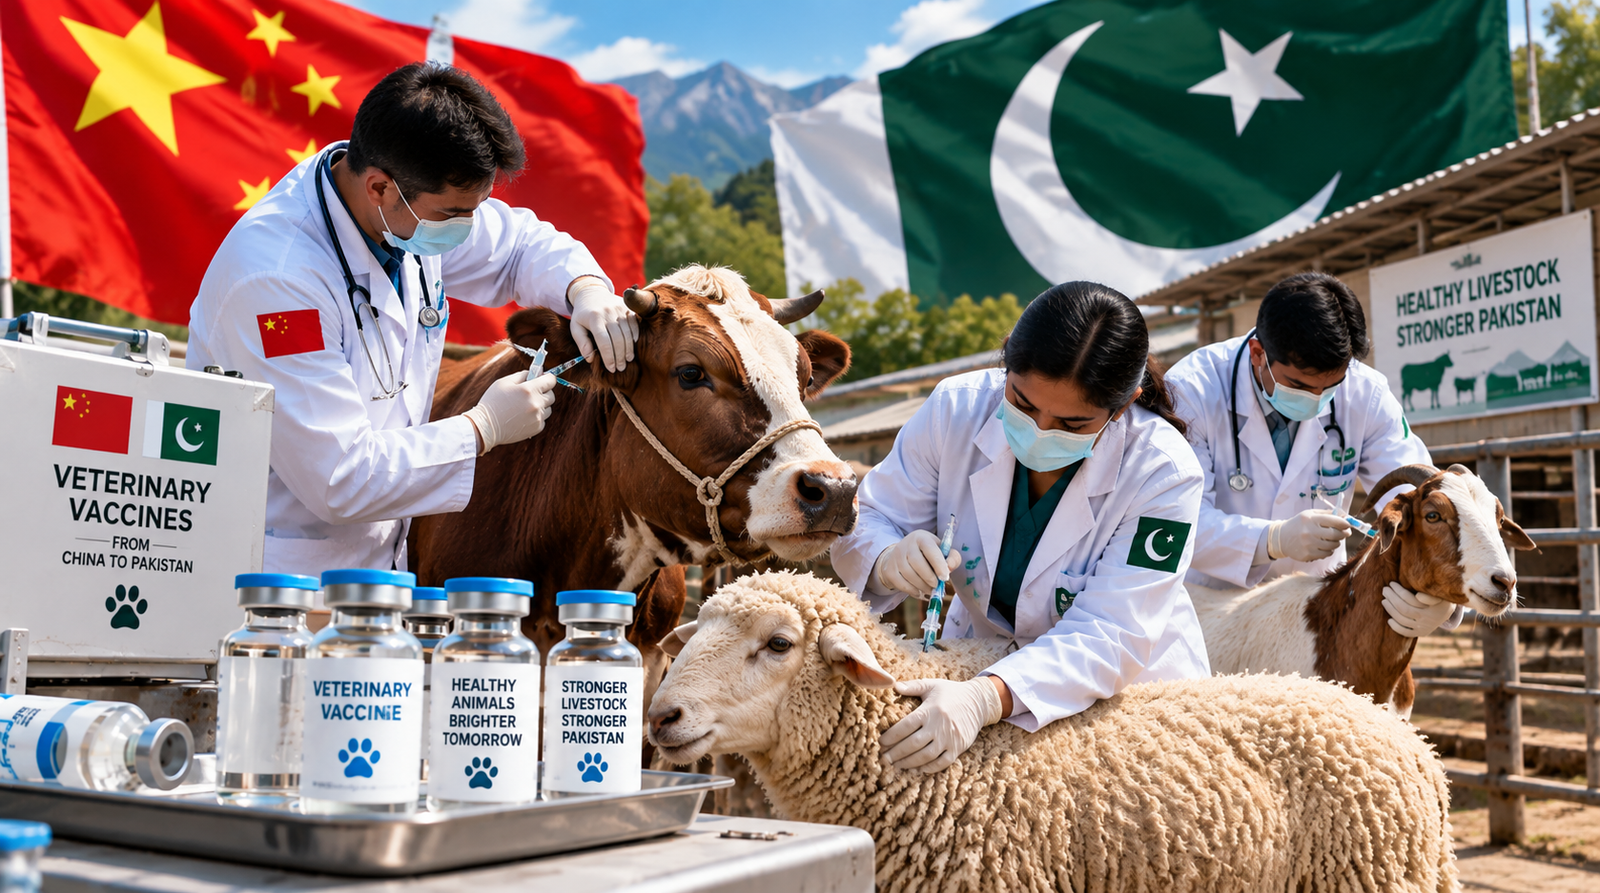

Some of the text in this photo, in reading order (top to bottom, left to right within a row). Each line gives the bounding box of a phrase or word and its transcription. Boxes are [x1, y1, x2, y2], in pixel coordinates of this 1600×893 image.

[1396, 281, 1464, 317] HEALTHY
[1468, 258, 1560, 302] LIVESTOCK
[1397, 294, 1562, 348] STRONGER PAKISTAN
[53, 463, 212, 504] VETERINARY
[69, 497, 193, 532] VACCINES
[112, 536, 150, 551] FROM
[62, 550, 194, 574] CHINA TO PAKISTAN
[313, 680, 412, 697] VETERINARY
[451, 678, 517, 692] HEALTHY
[561, 680, 628, 694] STRONGER
[451, 696, 515, 710] ANIMALS
[561, 697, 627, 710] LIVESTOCK
[449, 714, 517, 728] BRIGHTER
[561, 714, 627, 728] STRONGER
[442, 732, 523, 746] TOMORROW
[562, 731, 625, 744] PAKISTAN
